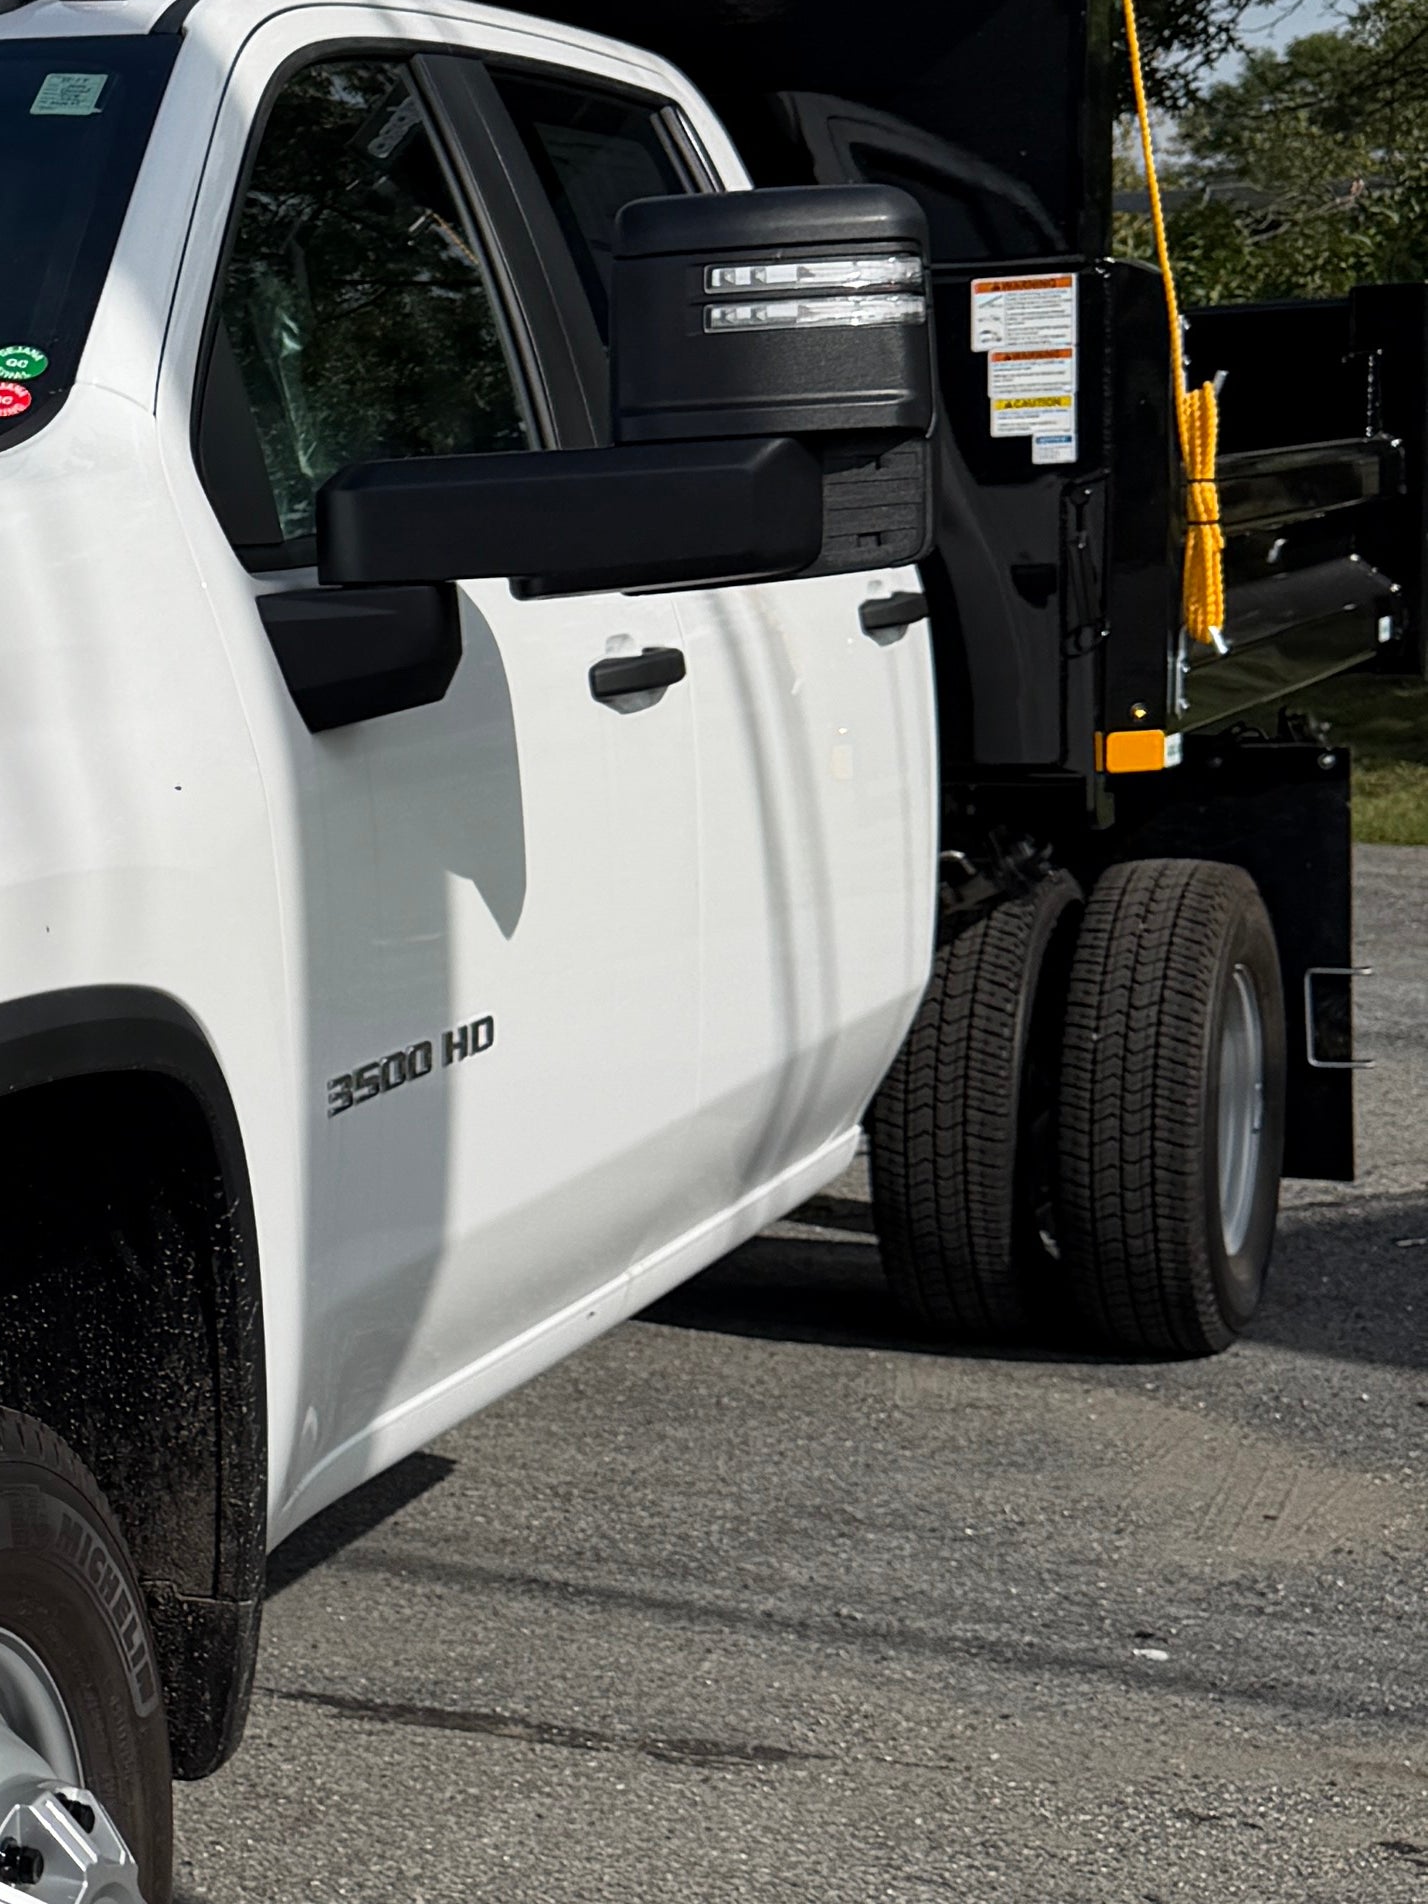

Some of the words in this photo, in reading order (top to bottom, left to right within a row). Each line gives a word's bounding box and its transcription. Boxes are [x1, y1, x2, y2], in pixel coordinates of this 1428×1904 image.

[5, 357, 29, 369] QC
[327, 1040, 433, 1119] 3500
[442, 1015, 494, 1068] HD
[54, 1509, 158, 1700] MICHELIN
